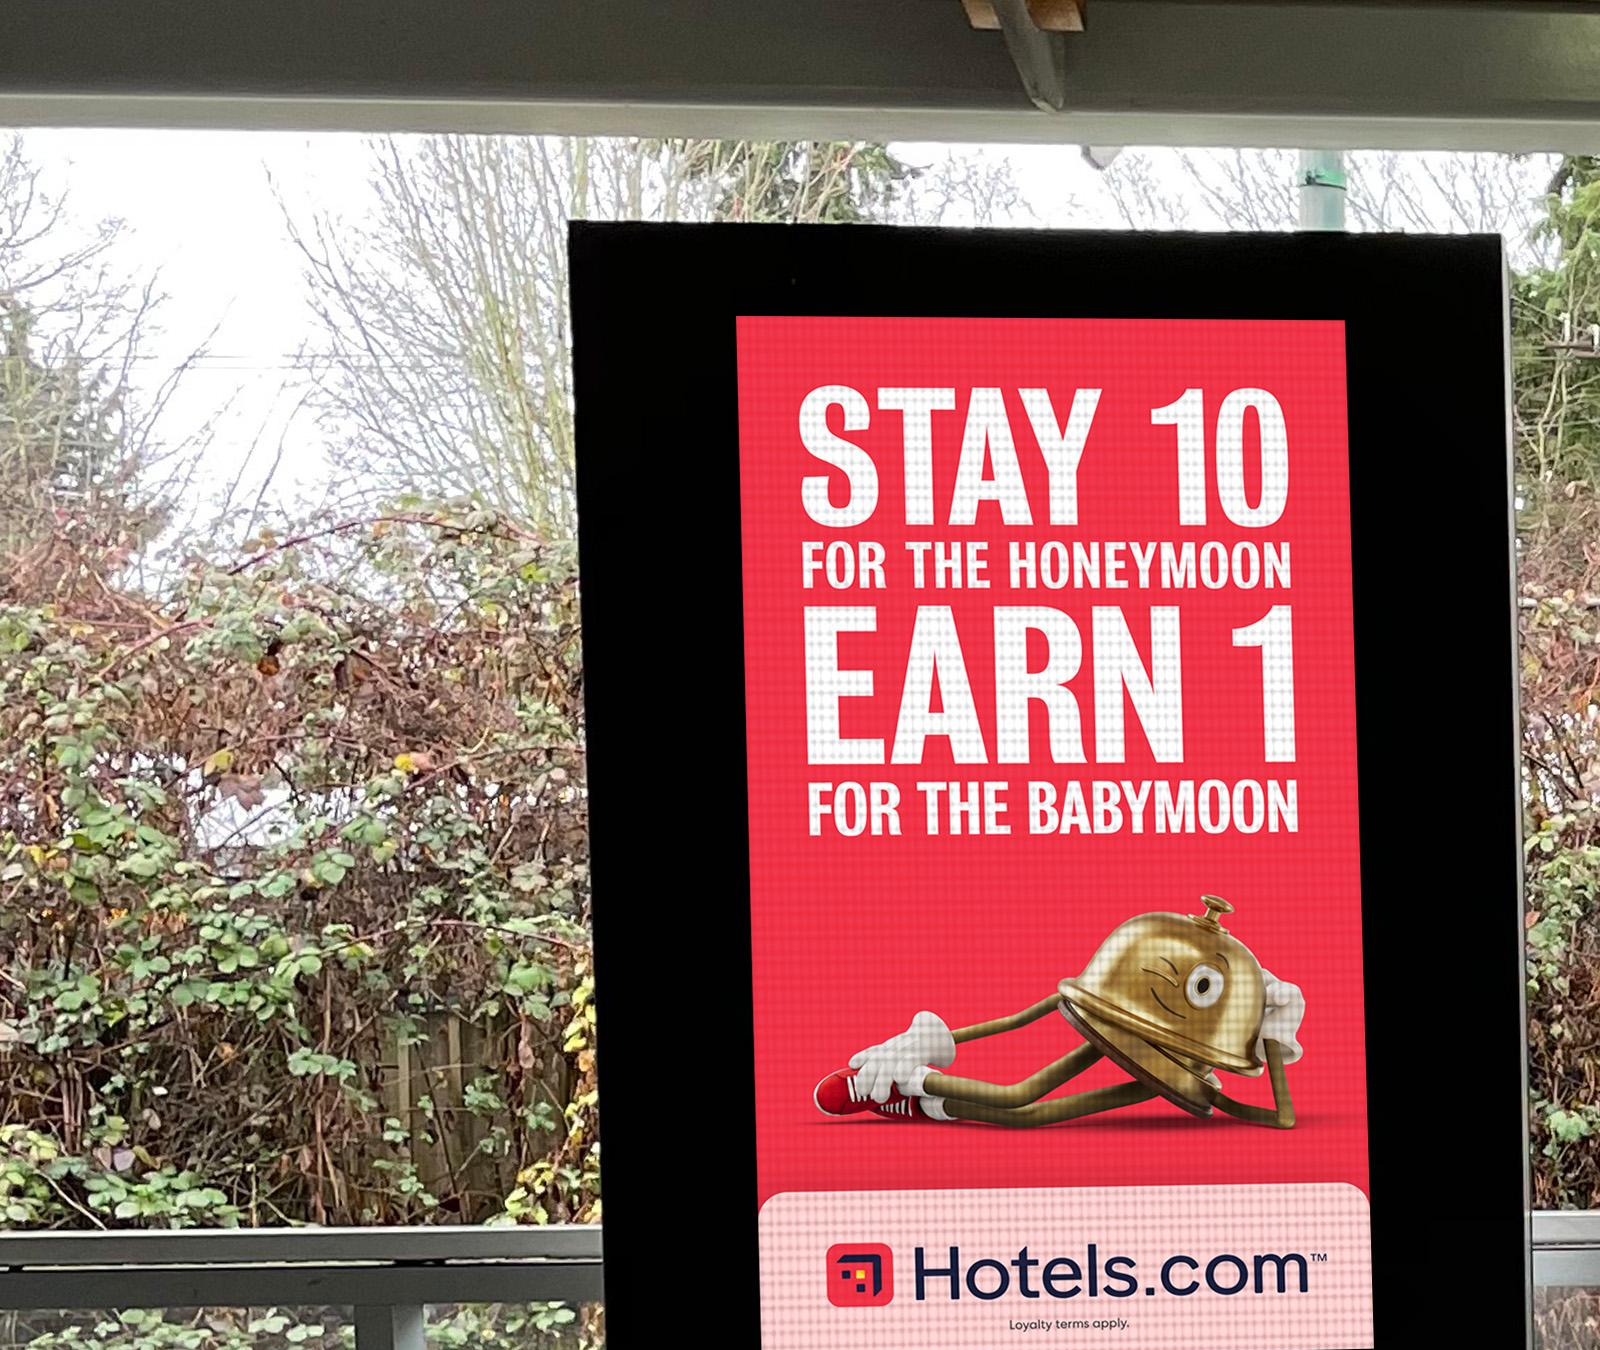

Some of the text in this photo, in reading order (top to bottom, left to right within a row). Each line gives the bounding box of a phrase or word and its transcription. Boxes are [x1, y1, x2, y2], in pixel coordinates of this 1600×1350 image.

[799, 385, 1289, 527] STAY 10
[802, 541, 1291, 590] FOR THE HONEYMOON
[804, 606, 1296, 765] EARN 1
[808, 780, 1299, 837] FOR THE BABYMOON
[1009, 1317, 1130, 1333] Loyalty terms apply.
